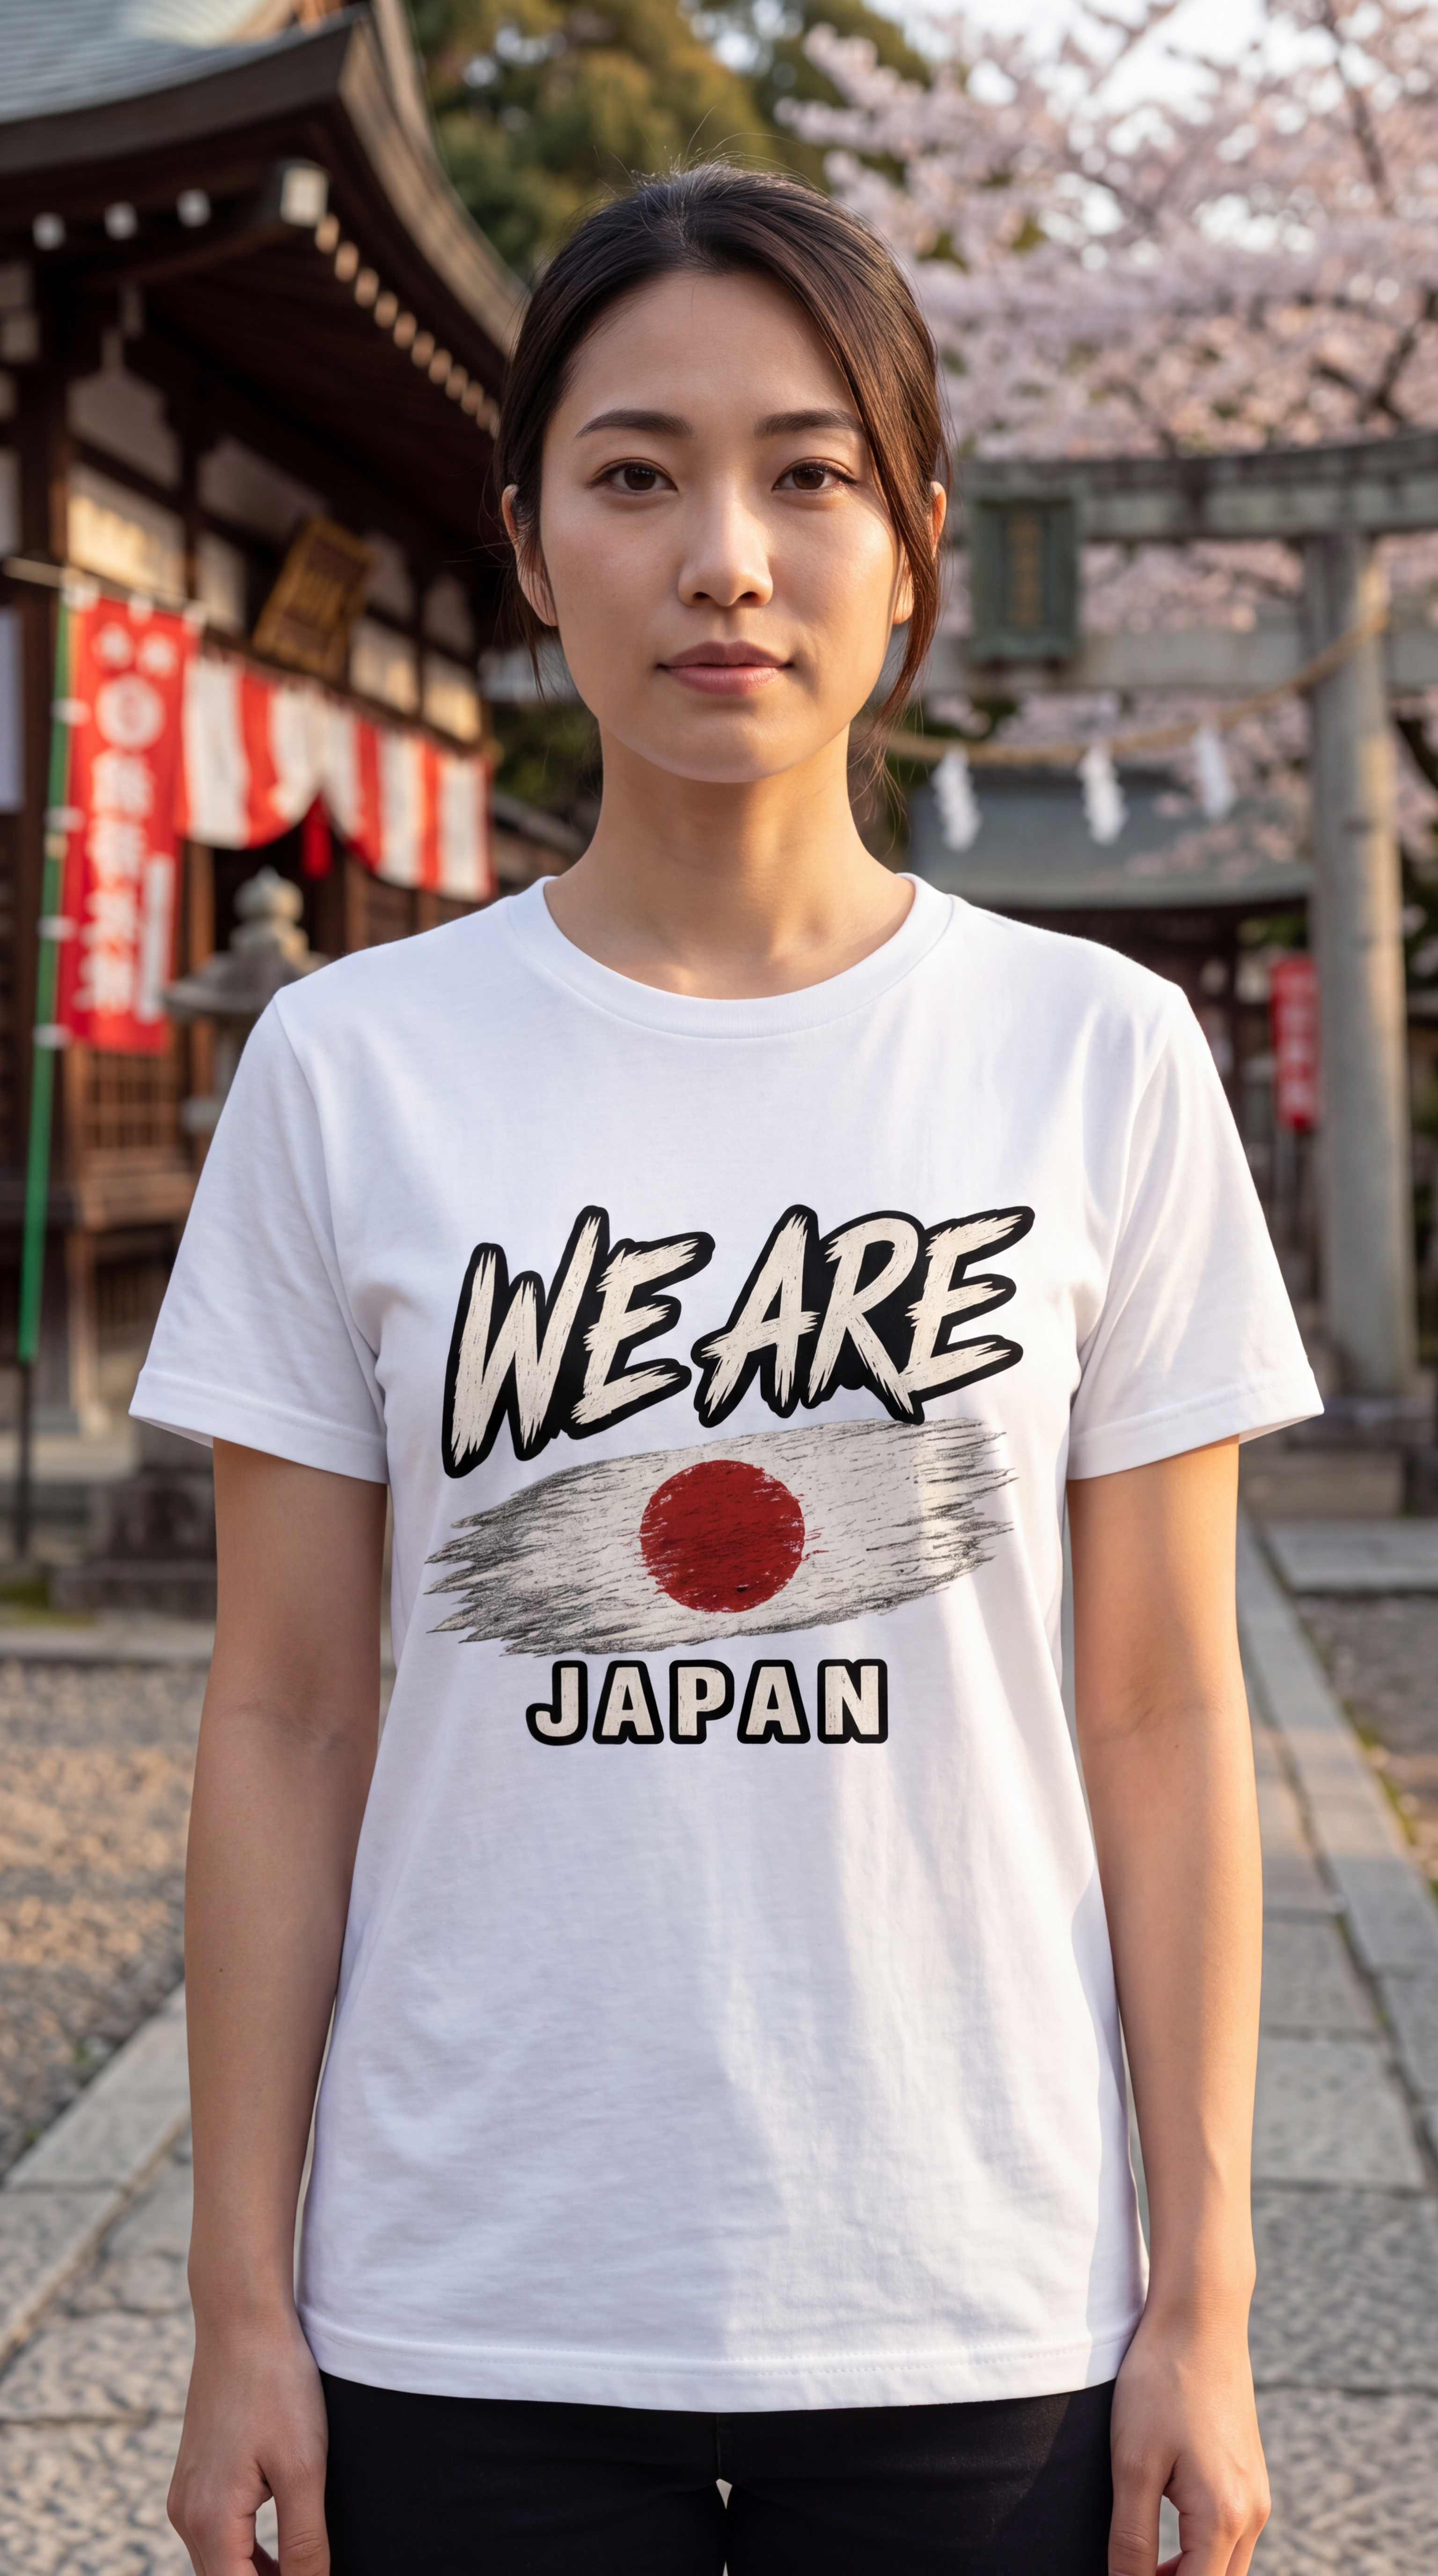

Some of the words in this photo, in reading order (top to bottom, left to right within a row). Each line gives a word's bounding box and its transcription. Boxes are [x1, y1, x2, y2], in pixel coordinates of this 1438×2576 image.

[441, 1206, 715, 1478] WE
[690, 1205, 1034, 1427] ARE
[526, 1659, 888, 1745] JAPAN
